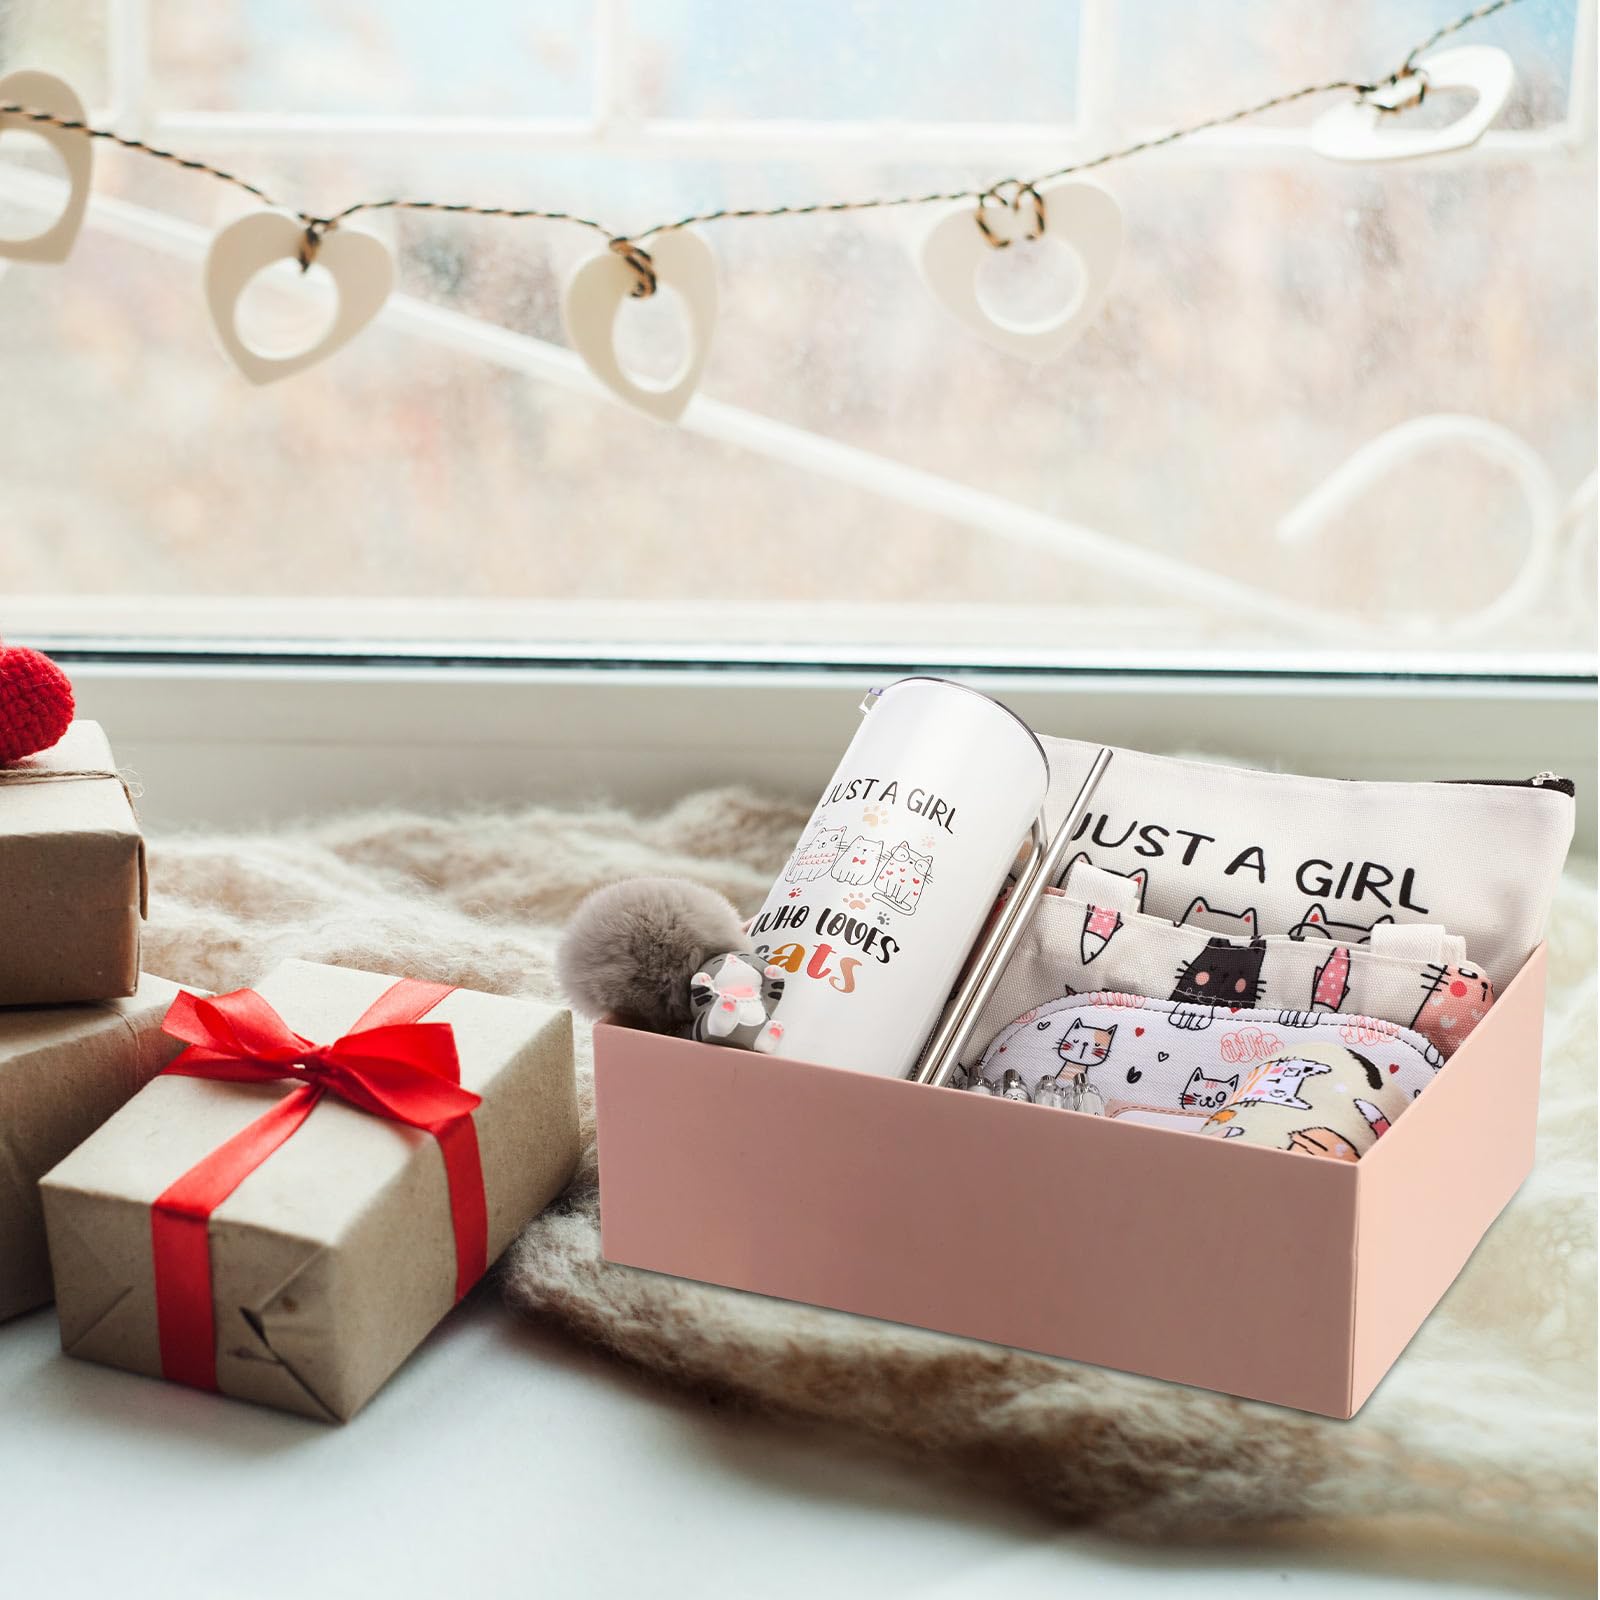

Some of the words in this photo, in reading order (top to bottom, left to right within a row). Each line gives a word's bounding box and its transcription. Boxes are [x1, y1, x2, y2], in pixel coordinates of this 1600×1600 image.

[822, 778, 879, 808] JUST
[879, 781, 898, 804] A
[907, 788, 960, 834] GIRL
[1071, 812, 1215, 866] JUST
[1224, 846, 1266, 883] A
[1295, 859, 1429, 914] GIRL
[750, 905, 810, 937] WHO
